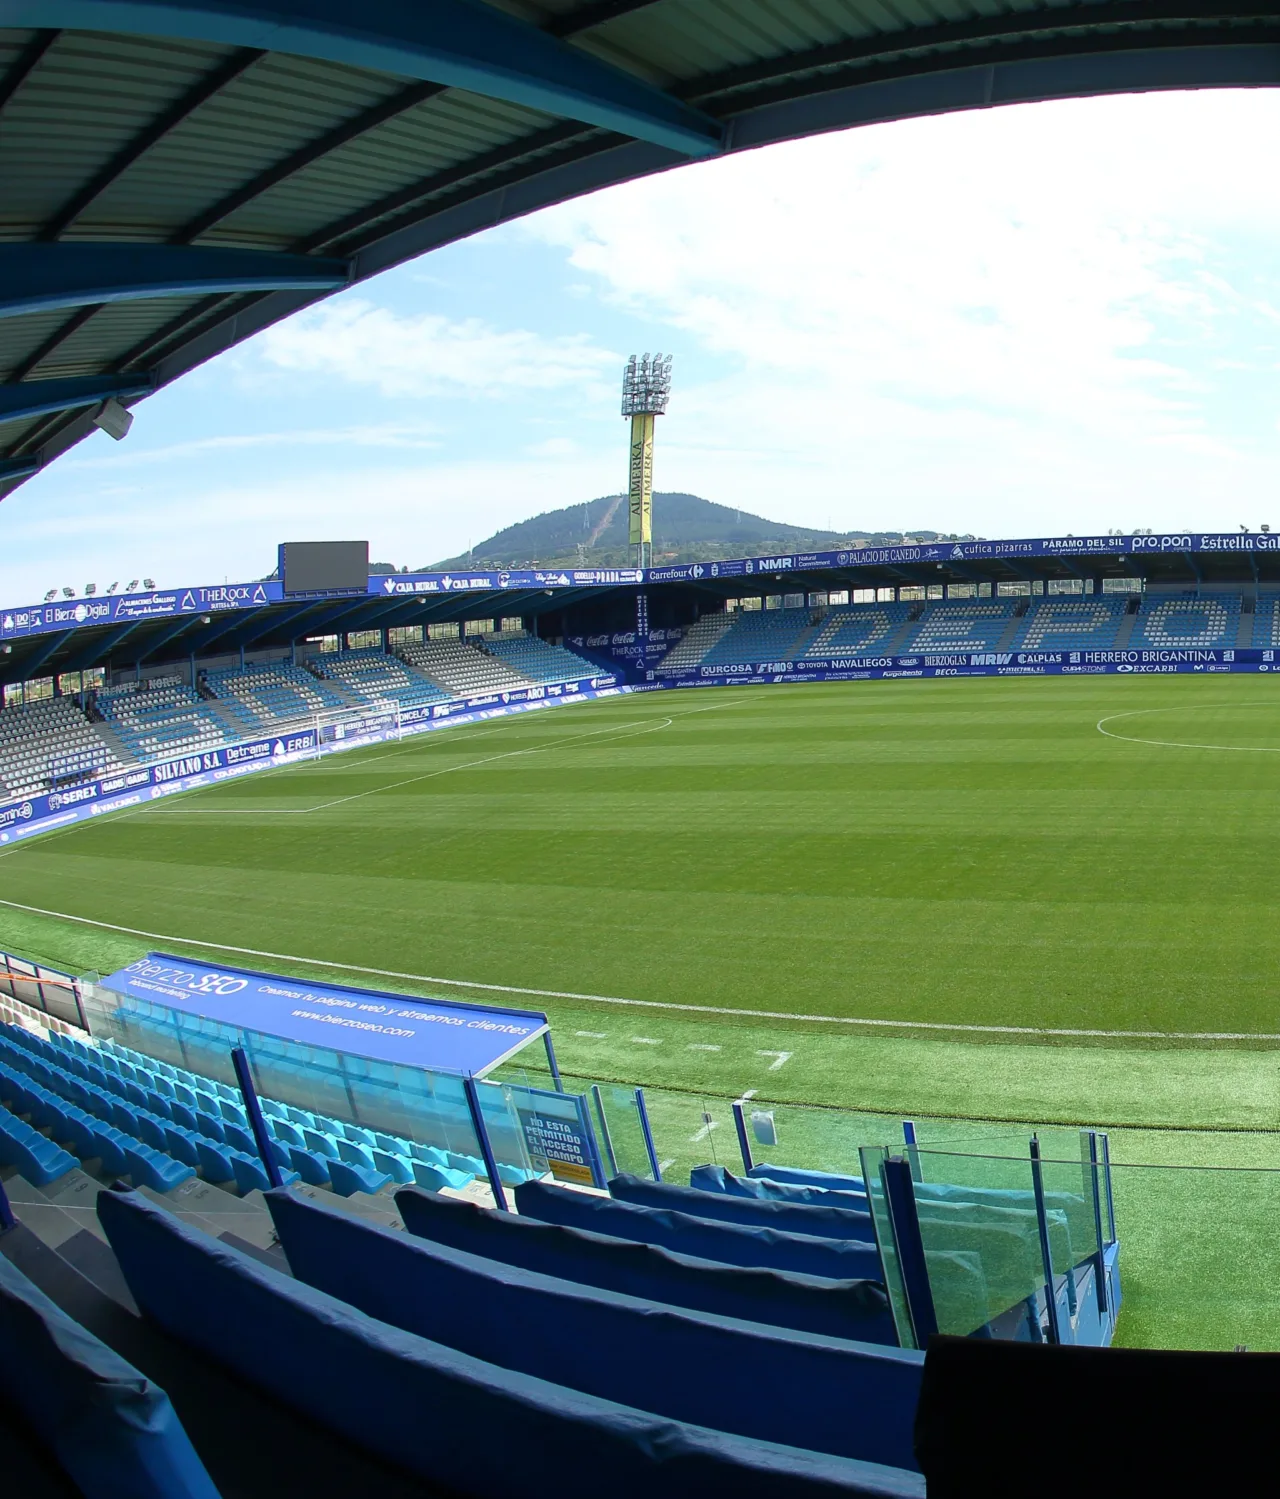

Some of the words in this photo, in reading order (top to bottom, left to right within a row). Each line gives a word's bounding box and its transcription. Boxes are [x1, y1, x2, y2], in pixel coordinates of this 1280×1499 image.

[631, 442, 643, 516] ALIMERKA
[643, 442, 652, 514] ALIMERKA
[964, 544, 992, 554] cufica
[995, 543, 1033, 554] pizarras
[1043, 539, 1084, 549] PÁRAMO
[1087, 539, 1106, 547] DEL
[1109, 538, 1125, 546] SIL
[1200, 535, 1253, 549] Estrella
[849, 551, 879, 563] PALACIO
[879, 550, 888, 561] DE
[890, 548, 921, 560] CANEDO
[759, 558, 792, 570] NMR
[650, 569, 688, 580] Carrefour
[396, 582, 414, 592] CAJA
[415, 580, 440, 592] RURAL
[452, 579, 470, 589] CAJA
[471, 578, 493, 589] RURAL
[86, 602, 110, 620] Digital
[612, 632, 636, 645] Coca-Cola
[831, 658, 892, 668] NAVALIEGOS
[924, 655, 967, 666] BIERZOGLAS
[970, 653, 1013, 665] MRW
[1085, 652, 1138, 662] HERRERO
[1142, 651, 1217, 662] BRIGANTINA
[149, 677, 182, 690] NORTE
[527, 687, 545, 700] AROI
[226, 743, 270, 760] Detrame
[154, 757, 202, 782] SILVANO
[203, 752, 223, 771] S.A.
[60, 786, 97, 805] SEREX
[257, 985, 302, 1002] Creamos
[315, 994, 356, 1010] página
[357, 1002, 386, 1014] web
[397, 1008, 466, 1027] atraemos
[466, 1018, 530, 1037] clientes
[290, 1008, 417, 1039] www.bierzoseo.com
[529, 1116, 543, 1128] NO
[547, 1120, 571, 1134] ESTA
[525, 1126, 581, 1145] PERMITIDO
[528, 1135, 540, 1146] EL
[541, 1138, 581, 1154] ACCESO
[533, 1146, 546, 1157] AL
[546, 1148, 584, 1165] CAMPO
